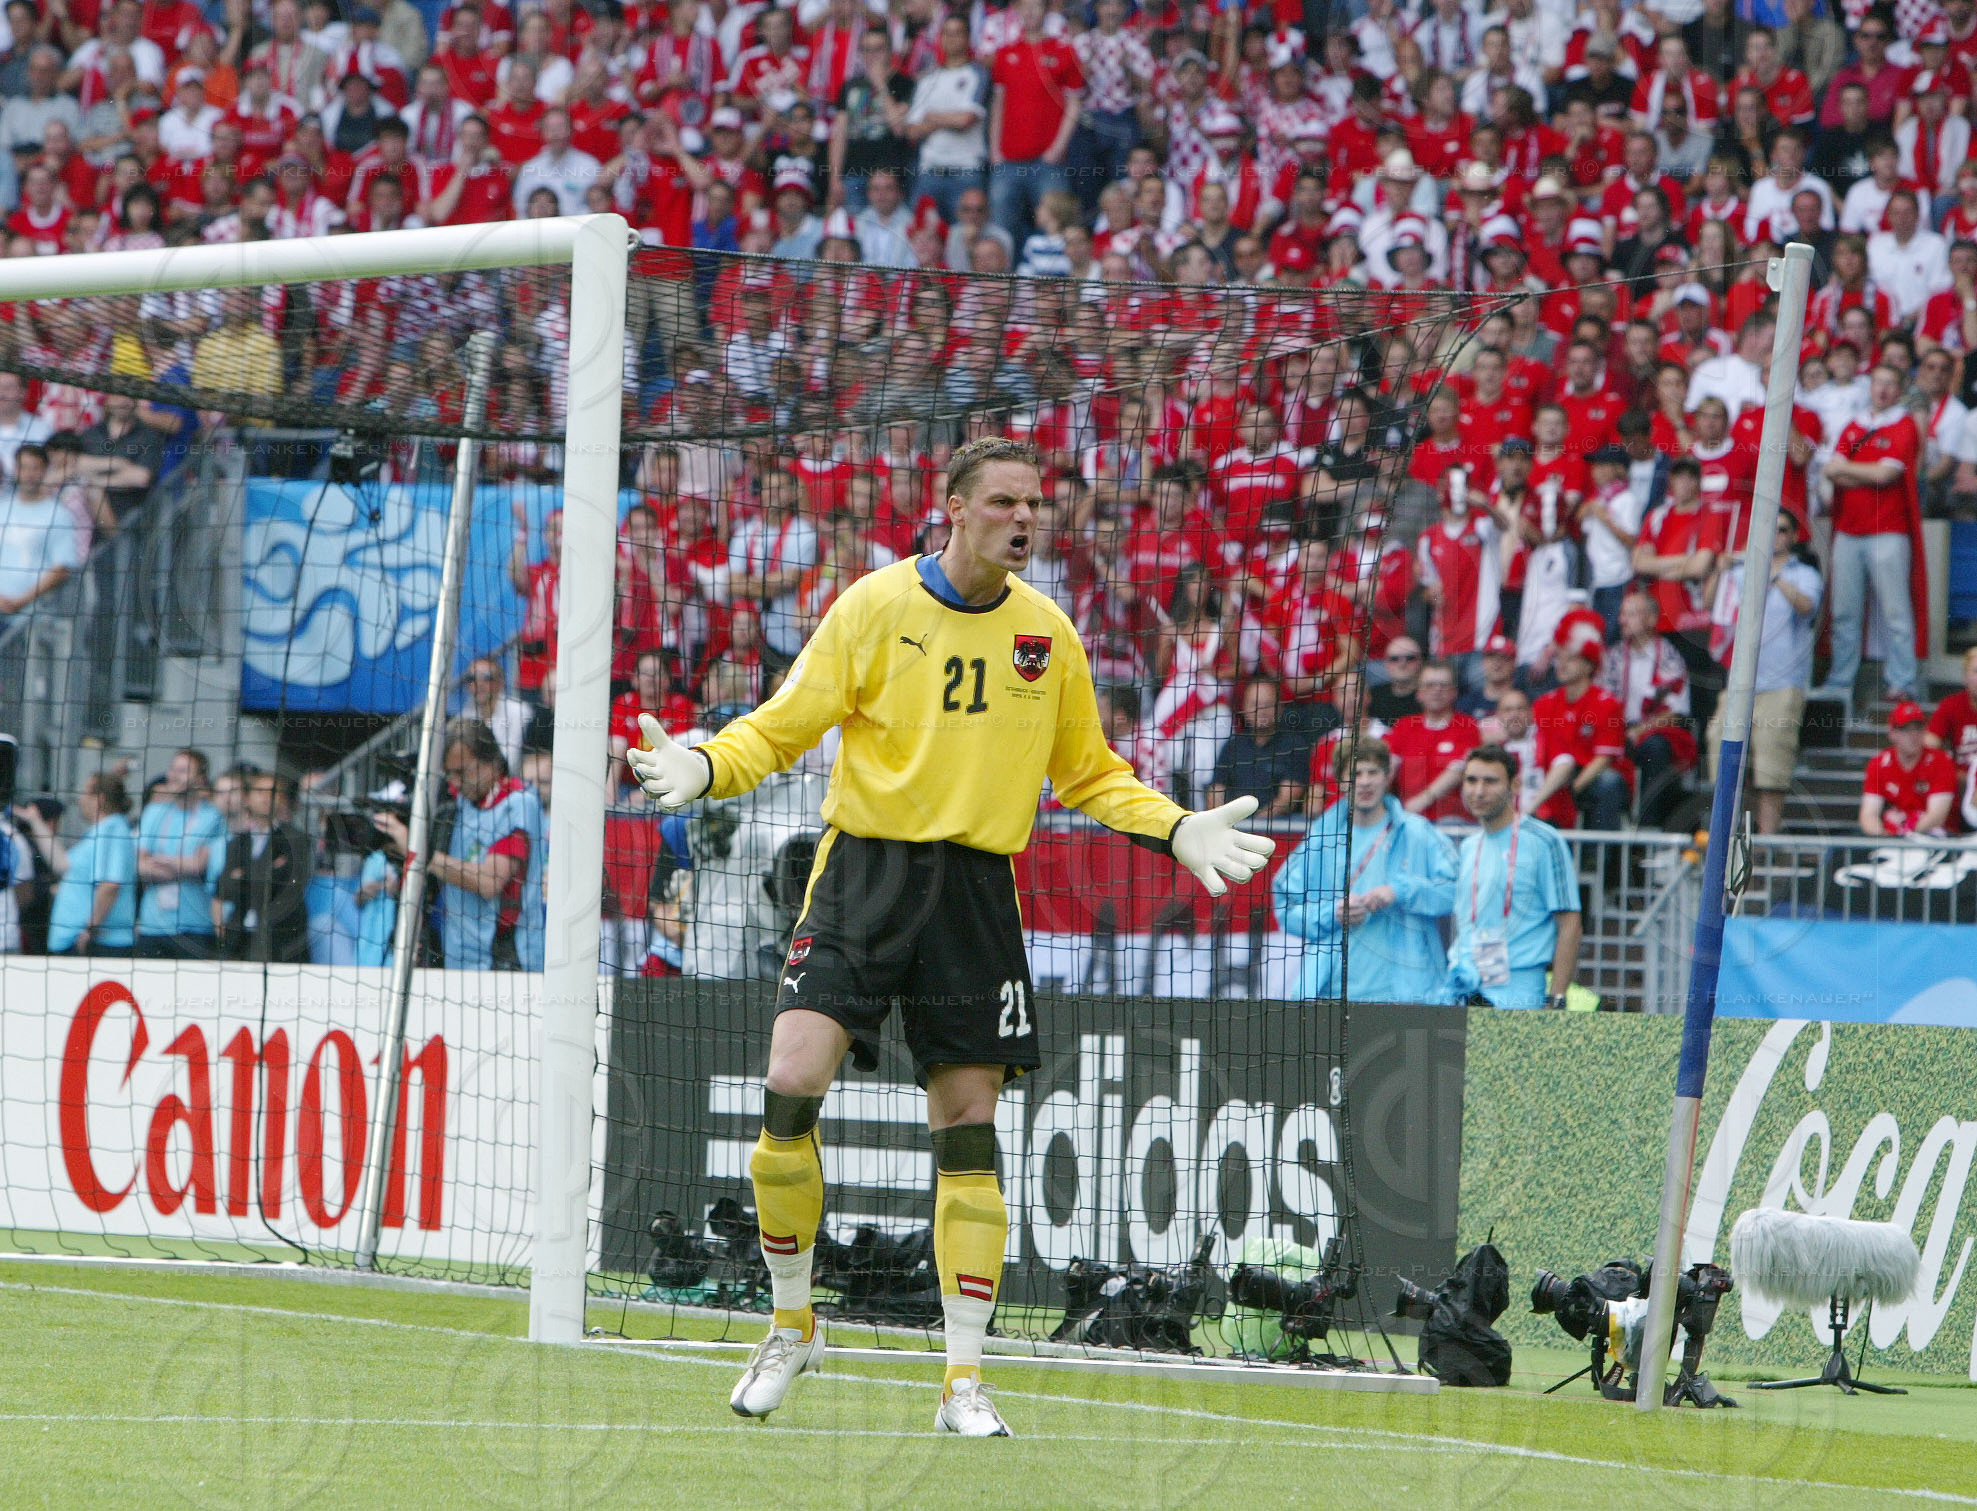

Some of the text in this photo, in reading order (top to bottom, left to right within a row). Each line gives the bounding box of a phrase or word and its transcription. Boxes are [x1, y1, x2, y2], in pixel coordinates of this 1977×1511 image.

[943, 655, 988, 714] 21
[998, 980, 1032, 1038] 21
[59, 980, 448, 1231] Canon
